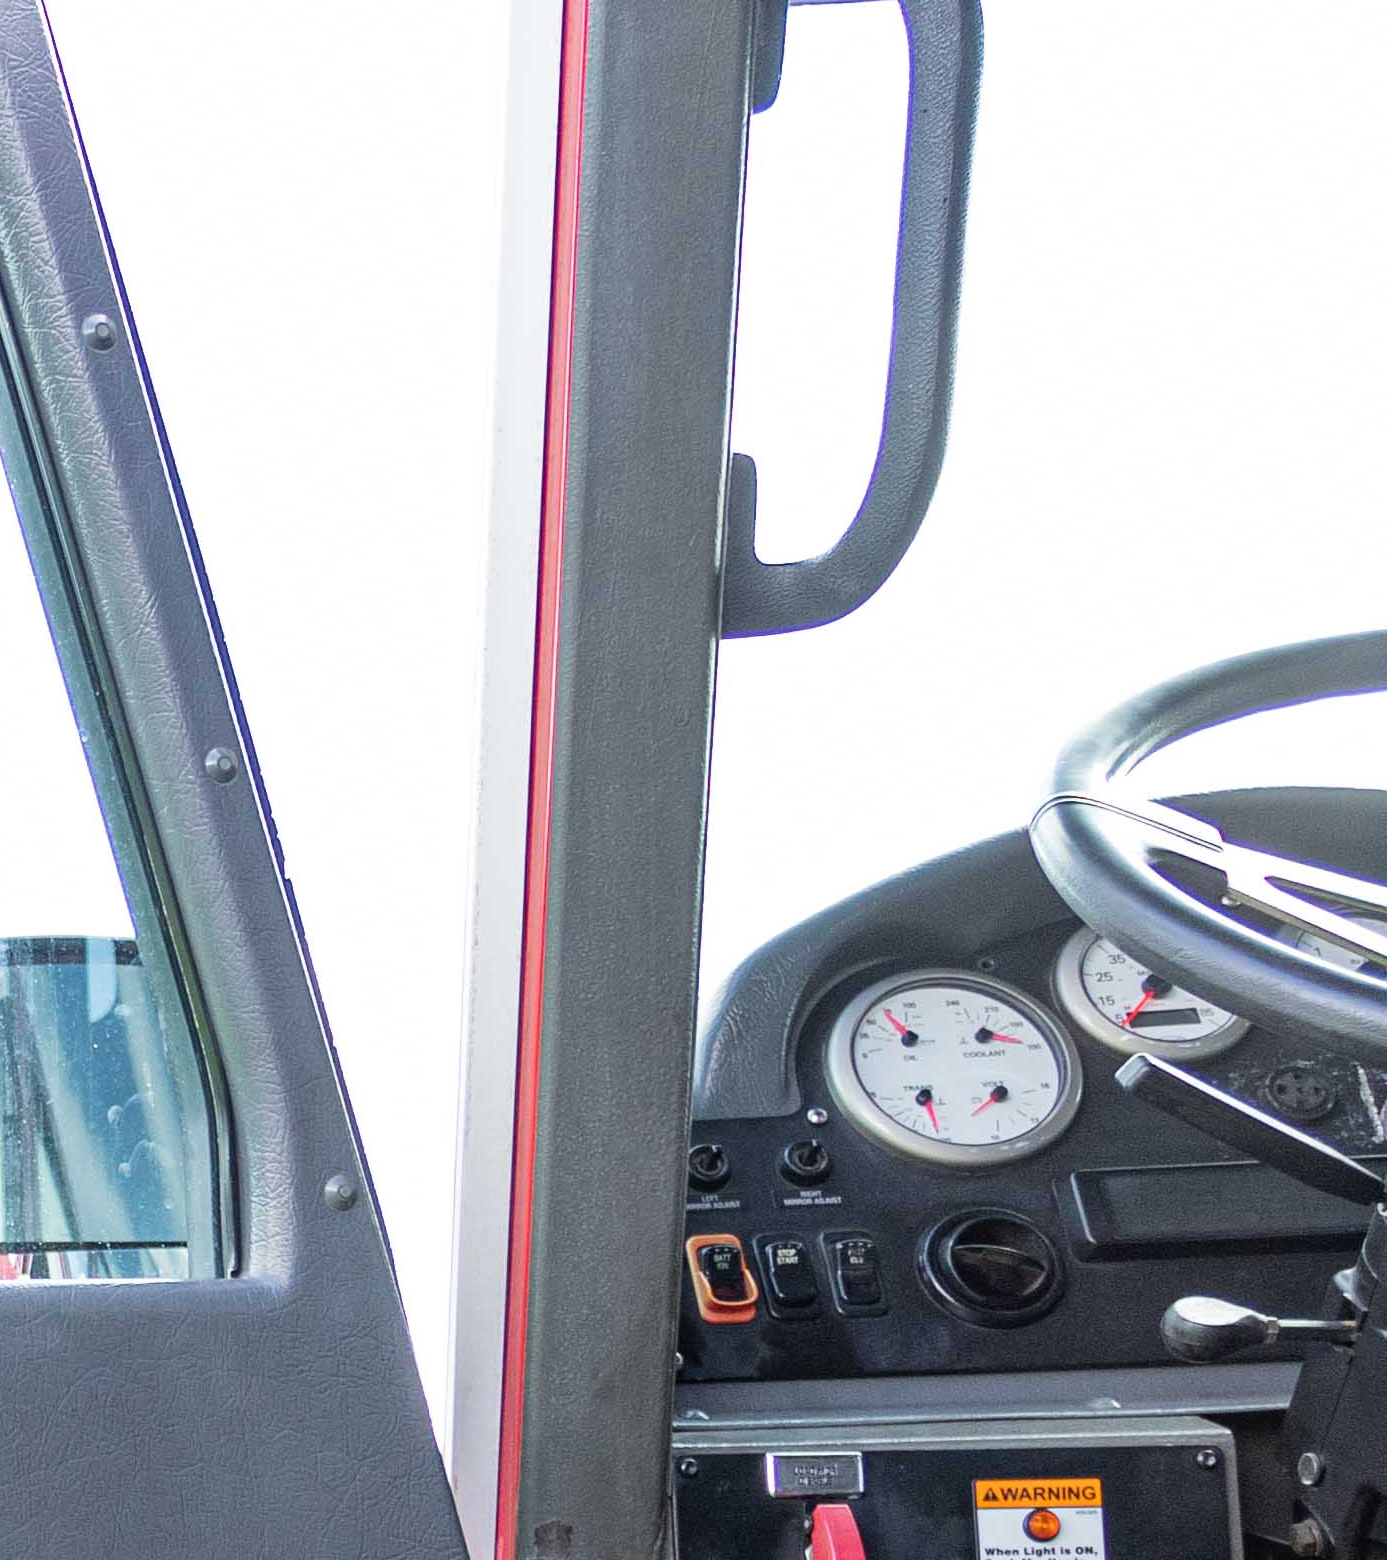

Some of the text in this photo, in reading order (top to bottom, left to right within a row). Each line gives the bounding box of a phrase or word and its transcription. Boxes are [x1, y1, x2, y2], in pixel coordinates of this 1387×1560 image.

[1108, 954, 1125, 964] 35
[1096, 972, 1113, 982] 25
[1099, 995, 1115, 1006] 15
[963, 1050, 1005, 1058] COOLANT
[784, 1198, 813, 1206] MIRROR
[777, 1257, 798, 1265] START
[1001, 1486, 1096, 1501] WARNING
[985, 1547, 1098, 1557] When Light is ON,
